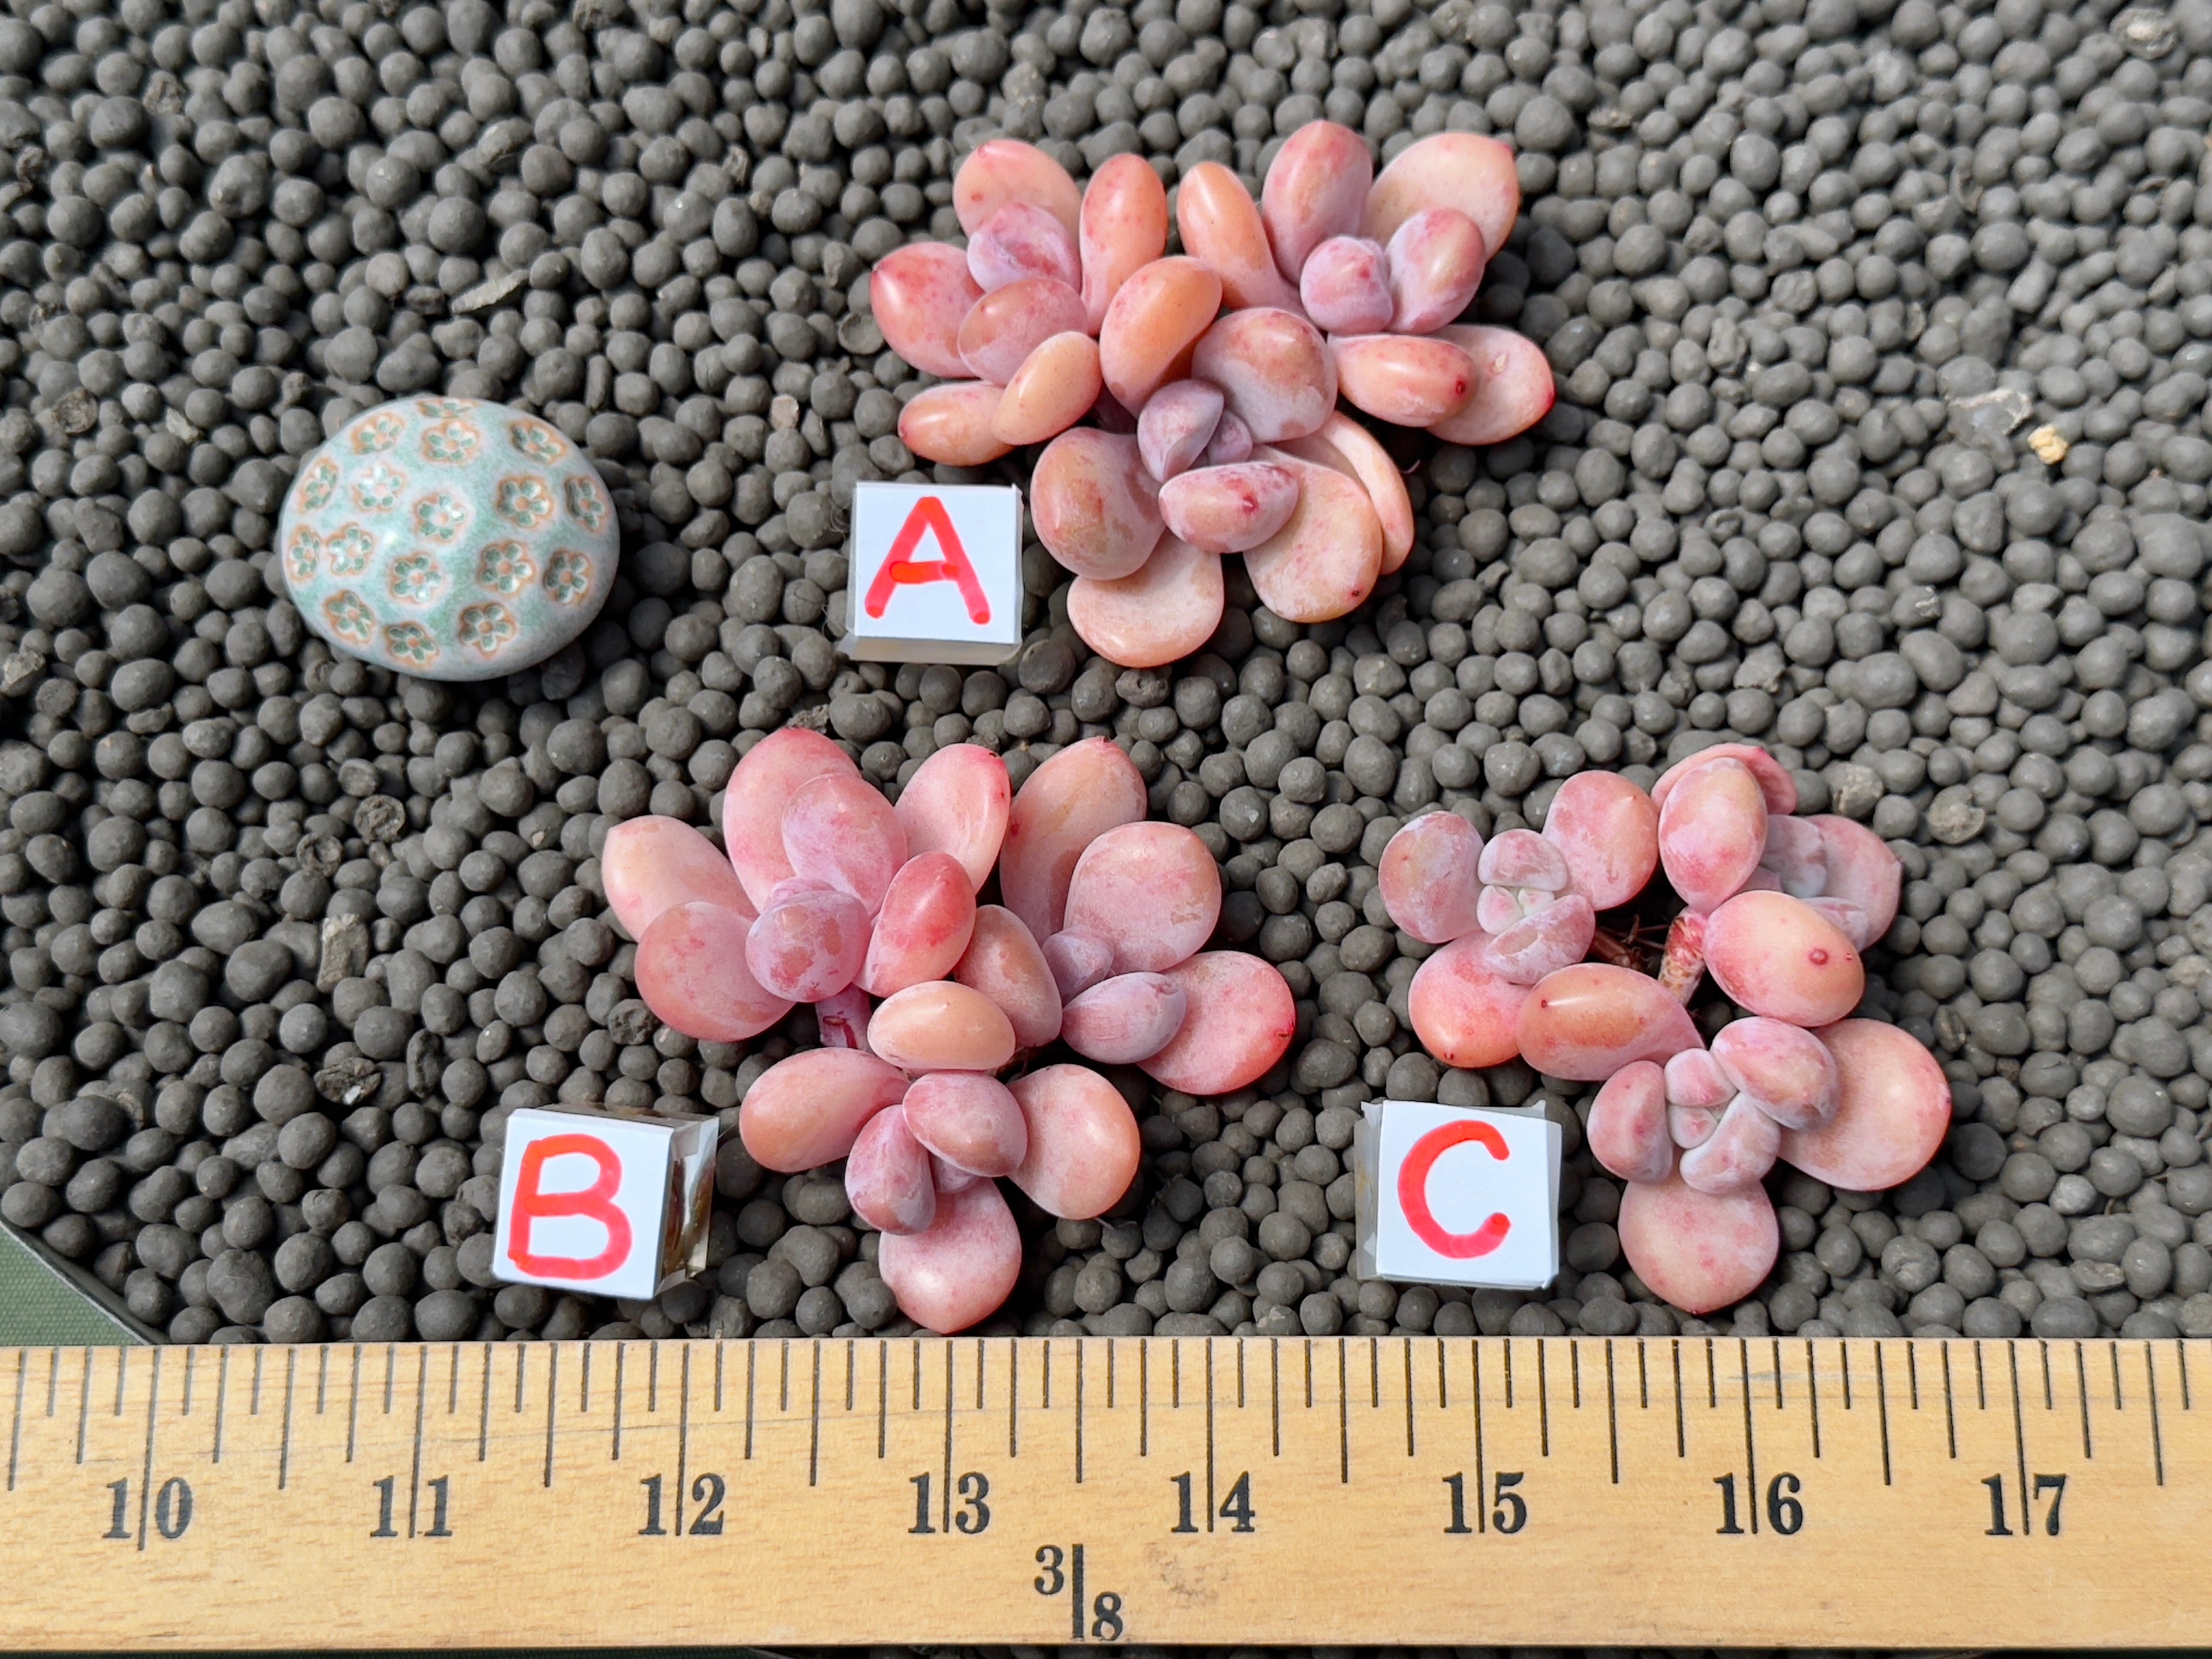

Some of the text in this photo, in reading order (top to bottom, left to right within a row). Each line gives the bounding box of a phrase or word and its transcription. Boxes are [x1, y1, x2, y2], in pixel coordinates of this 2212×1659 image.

[865, 495, 992, 626] A
[507, 1133, 633, 1281] B
[1397, 1119, 1512, 1260] C
[103, 1471, 2067, 1540] 10 11 12 13 14 15 16 17
